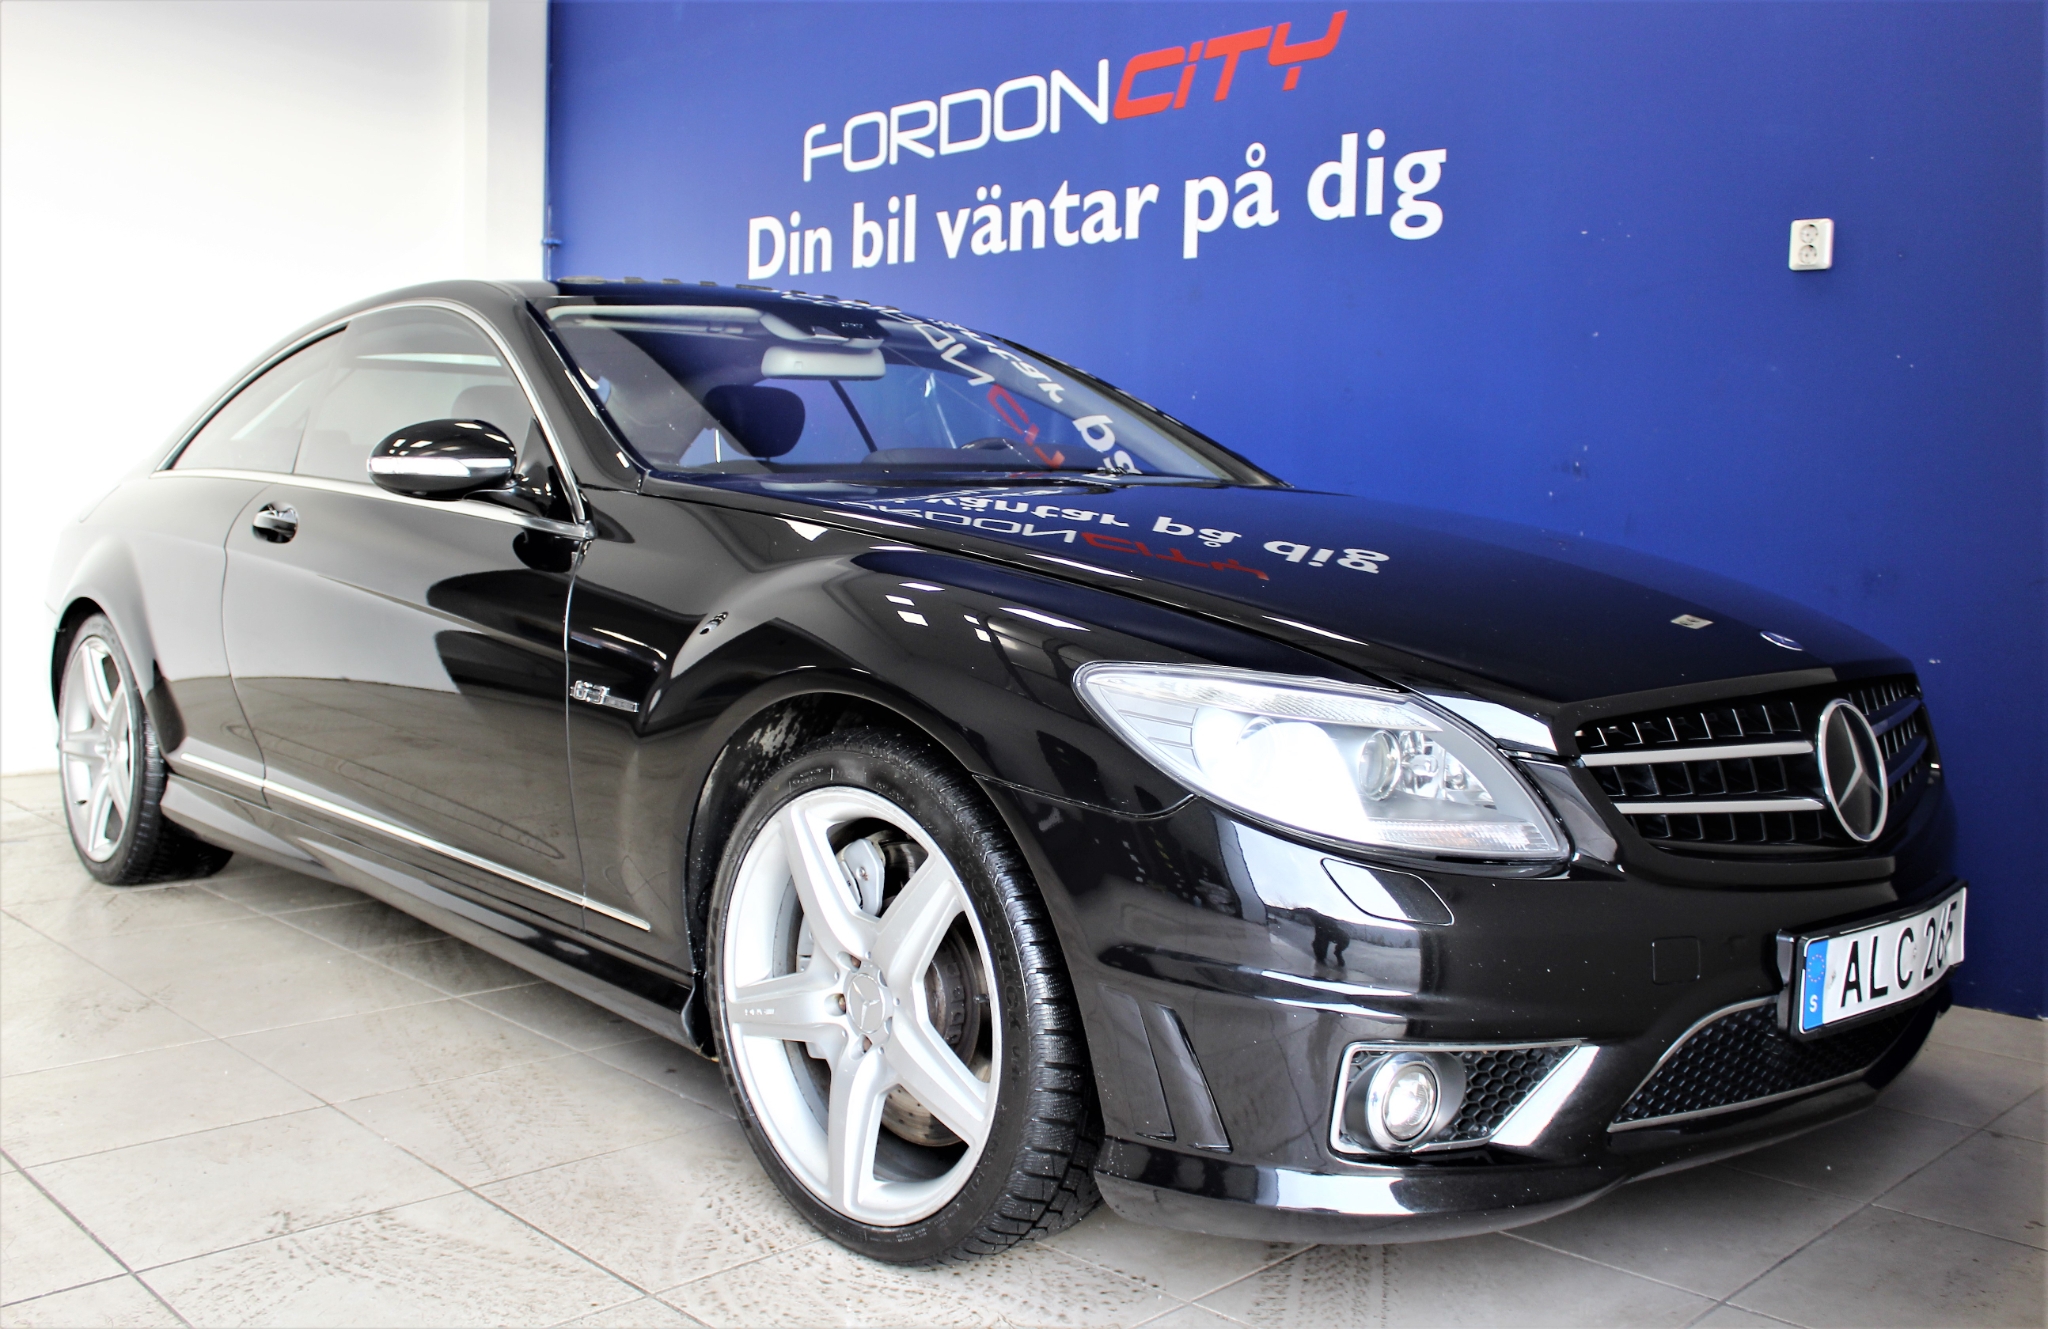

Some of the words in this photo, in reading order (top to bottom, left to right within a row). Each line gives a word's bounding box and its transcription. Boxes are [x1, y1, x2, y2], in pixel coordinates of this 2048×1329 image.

[747, 211, 832, 281] Din
[852, 194, 917, 269] bil
[936, 181, 1160, 260] väntar
[1183, 142, 1279, 259] på
[1307, 128, 1447, 240] dig
[1809, 995, 1818, 1013] S
[1840, 927, 1914, 1009] ALC
